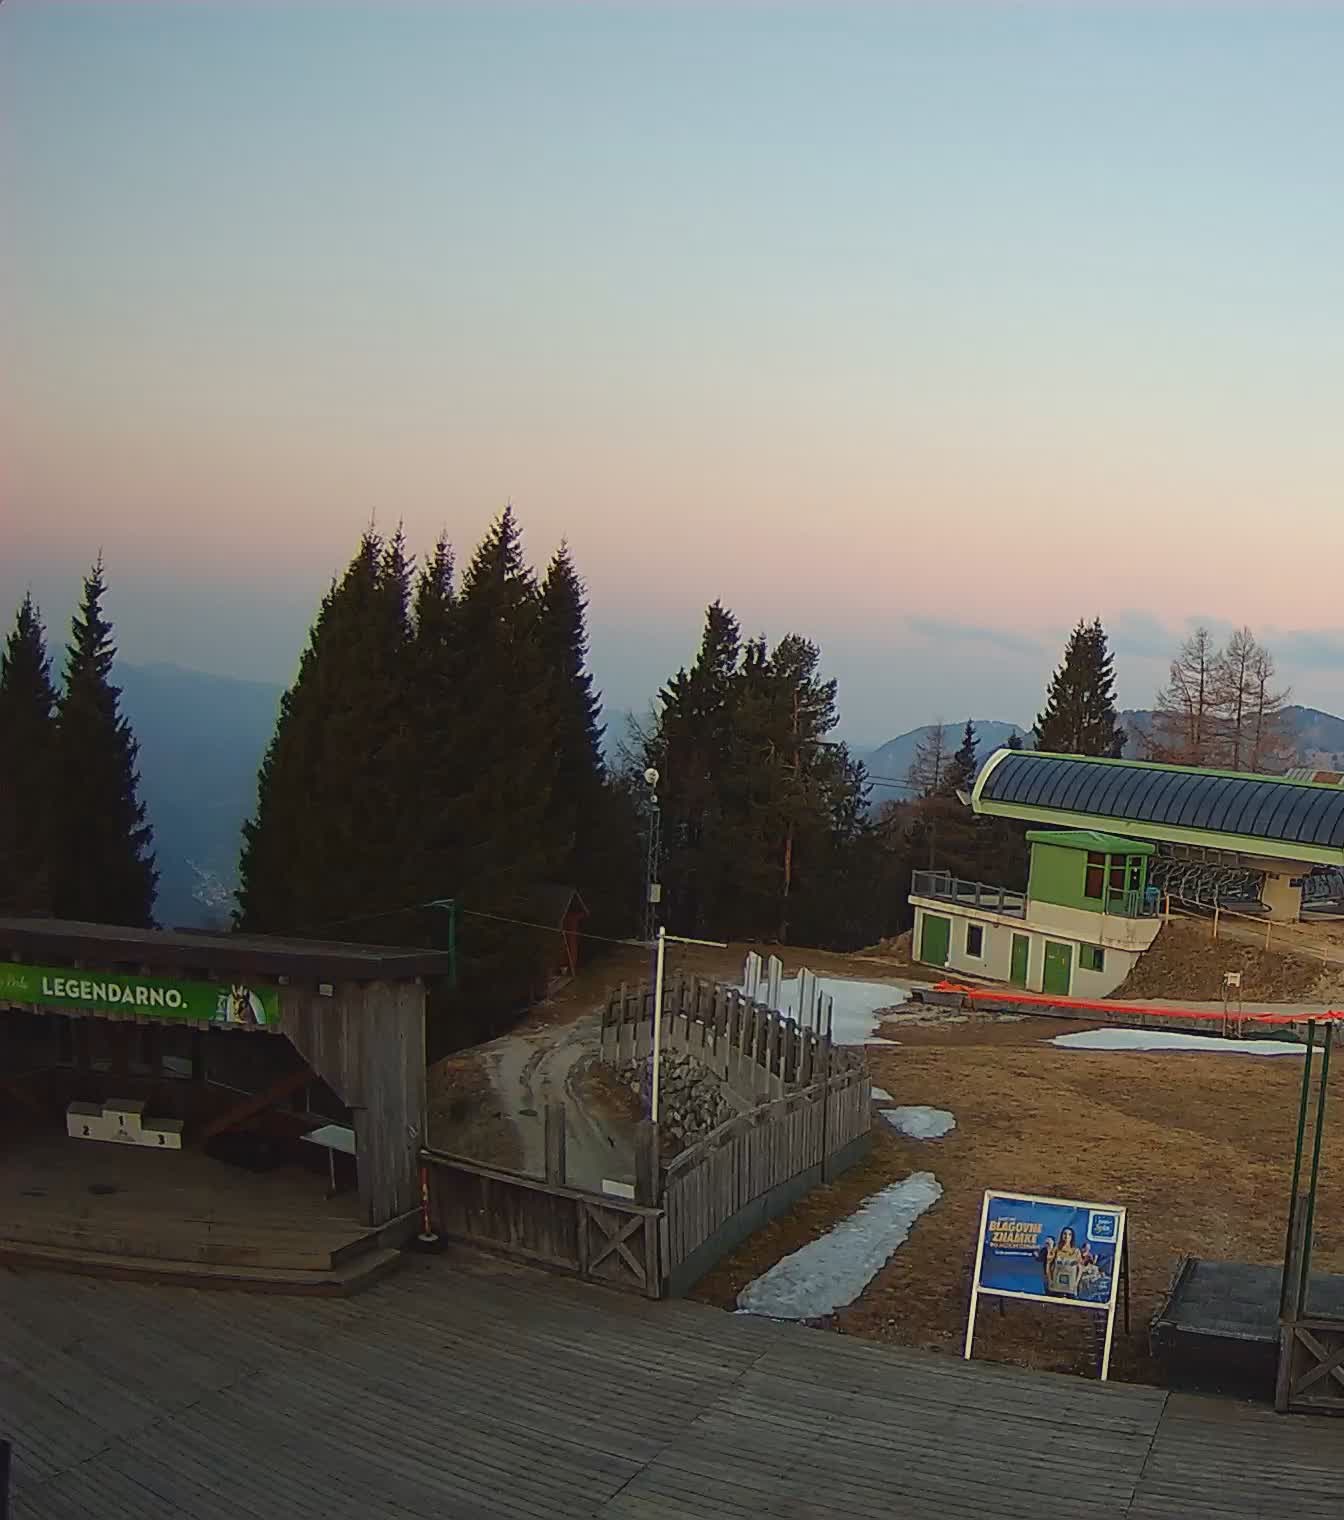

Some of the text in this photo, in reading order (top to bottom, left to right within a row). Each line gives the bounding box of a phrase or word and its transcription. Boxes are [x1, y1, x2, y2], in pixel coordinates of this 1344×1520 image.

[42, 976, 188, 1009] LEGENDARNO.
[83, 1125, 90, 1136] 2
[158, 1134, 165, 1145] 3
